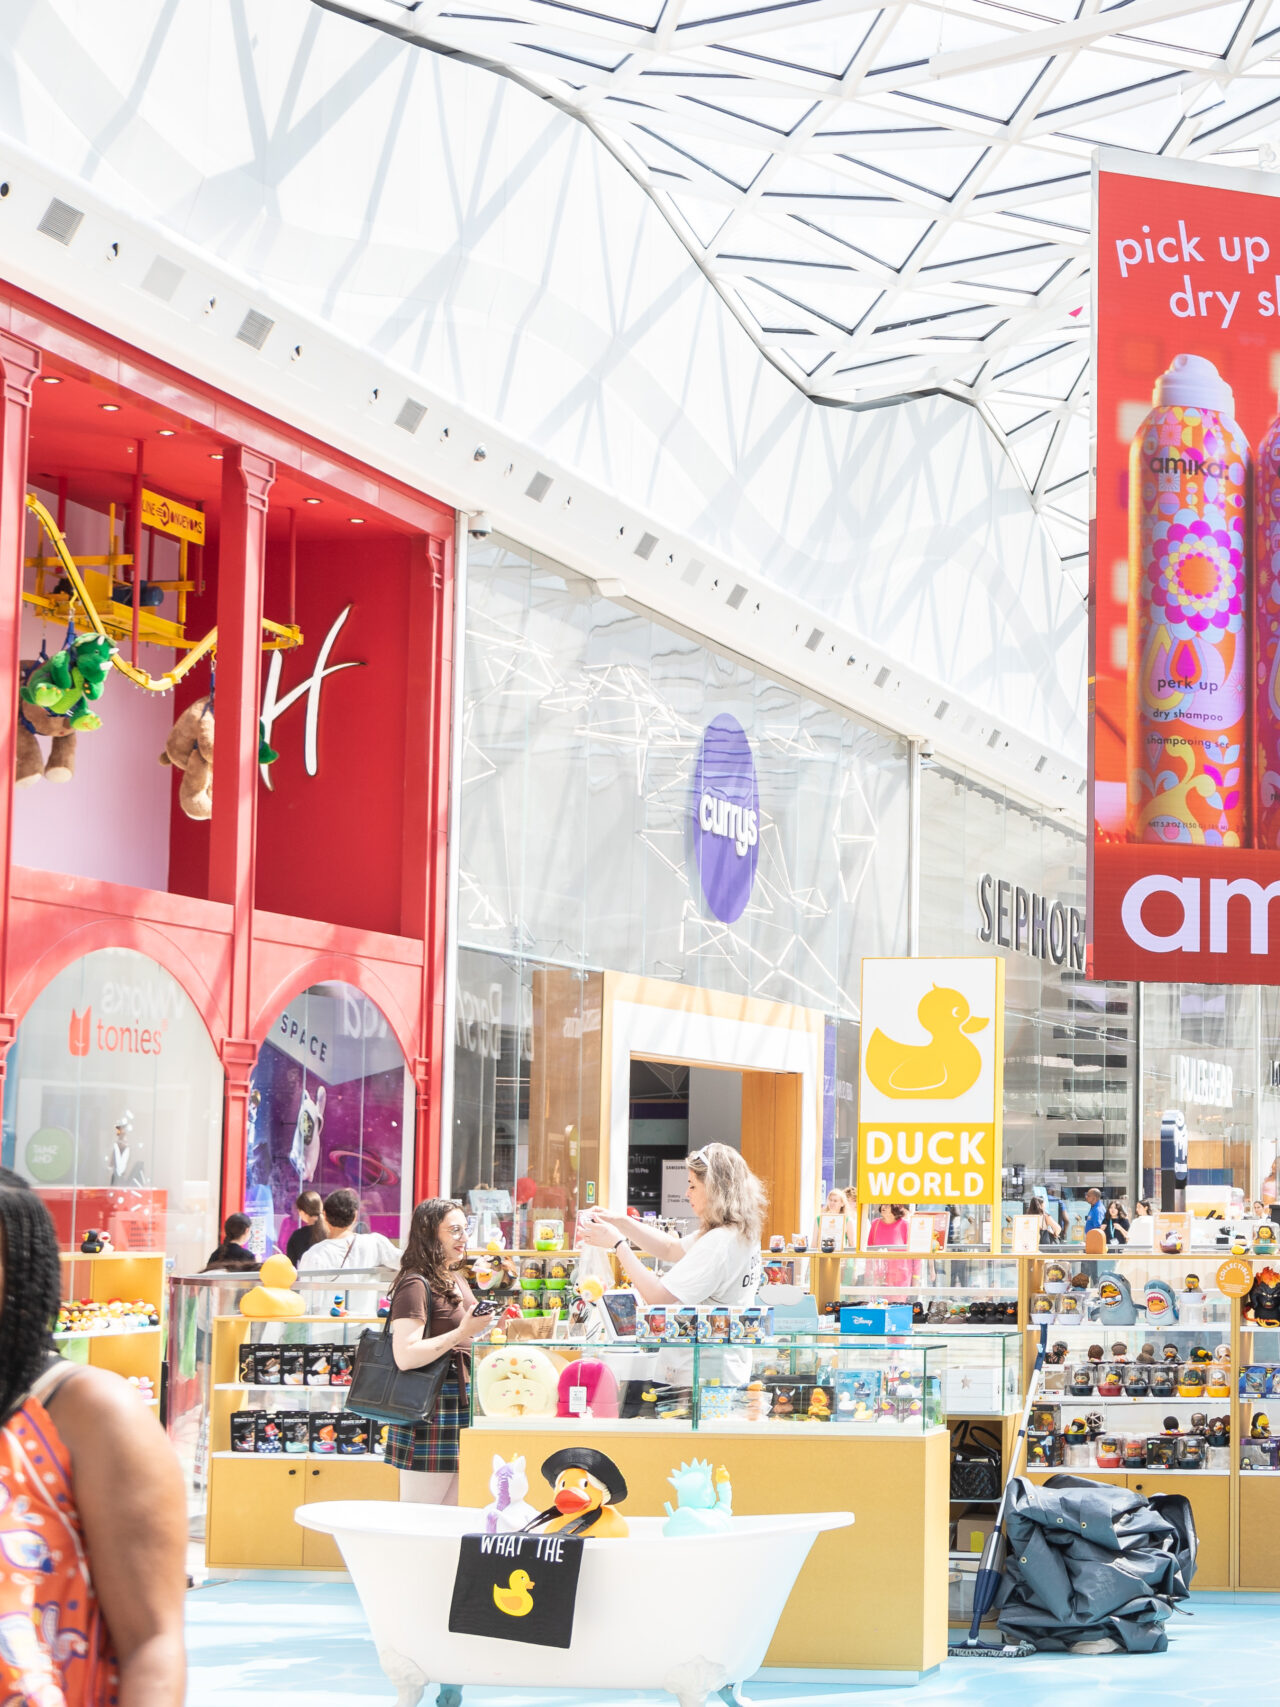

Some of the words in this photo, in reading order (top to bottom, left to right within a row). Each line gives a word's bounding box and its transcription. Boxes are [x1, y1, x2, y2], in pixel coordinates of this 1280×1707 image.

[1116, 220, 1205, 277] pick
[1218, 236, 1270, 274] up
[1169, 275, 1240, 329] dry
[1157, 676, 1193, 692] perk
[1199, 680, 1218, 694] up
[1153, 708, 1170, 720] dry
[1174, 709, 1223, 722] shampoo
[699, 793, 758, 857] currys
[96, 1018, 162, 1056] tonies
[280, 1012, 328, 1063] SPACE
[866, 1131, 986, 1165] DUCK
[868, 1171, 984, 1197] WORLD
[852, 1315, 873, 1327] Disney
[481, 1535, 528, 1558] WHAT
[536, 1536, 565, 1563] THE
